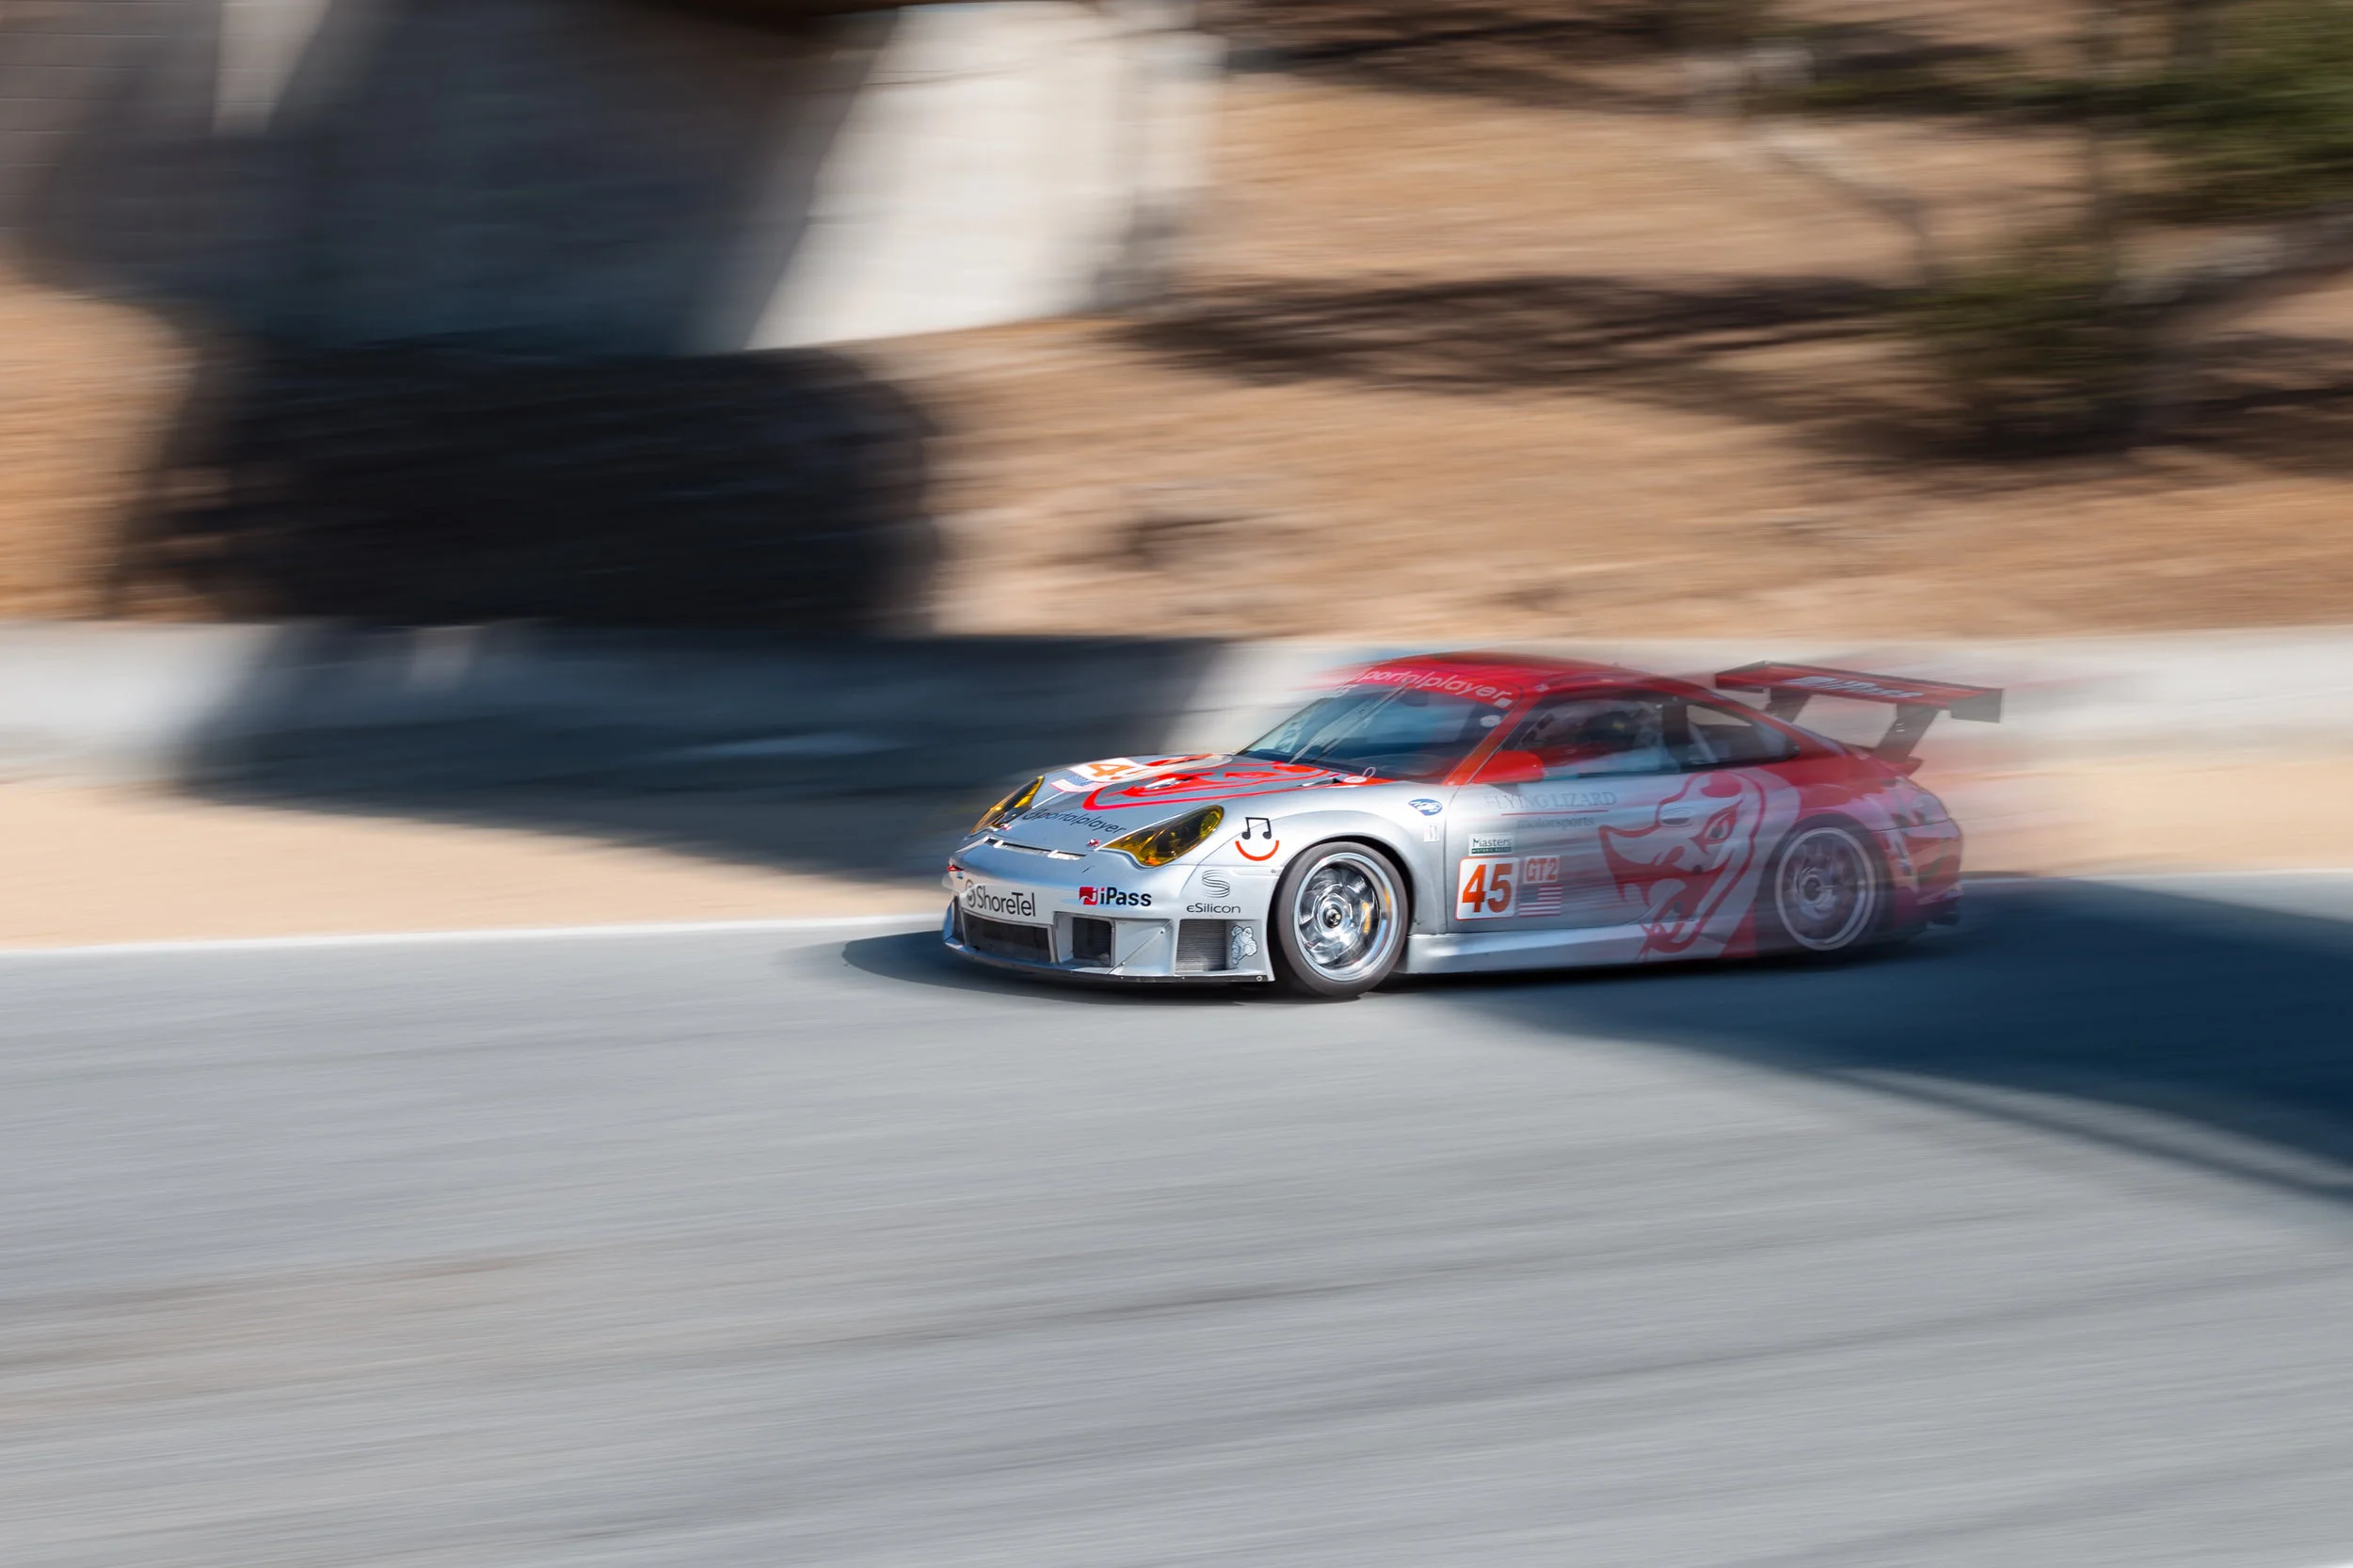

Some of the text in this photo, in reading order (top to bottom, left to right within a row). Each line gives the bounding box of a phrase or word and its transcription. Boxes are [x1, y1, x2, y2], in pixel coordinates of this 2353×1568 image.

[1484, 792, 1617, 809] FLYING LIZARD
[1517, 816, 1595, 830] motorsports
[1472, 838, 1513, 847] Masters
[1526, 857, 1558, 882] GT2
[1100, 887, 1152, 907] iPass
[1462, 863, 1513, 913] 45
[976, 886, 1035, 917] ShoreTel
[1187, 903, 1241, 914] eSilicon
